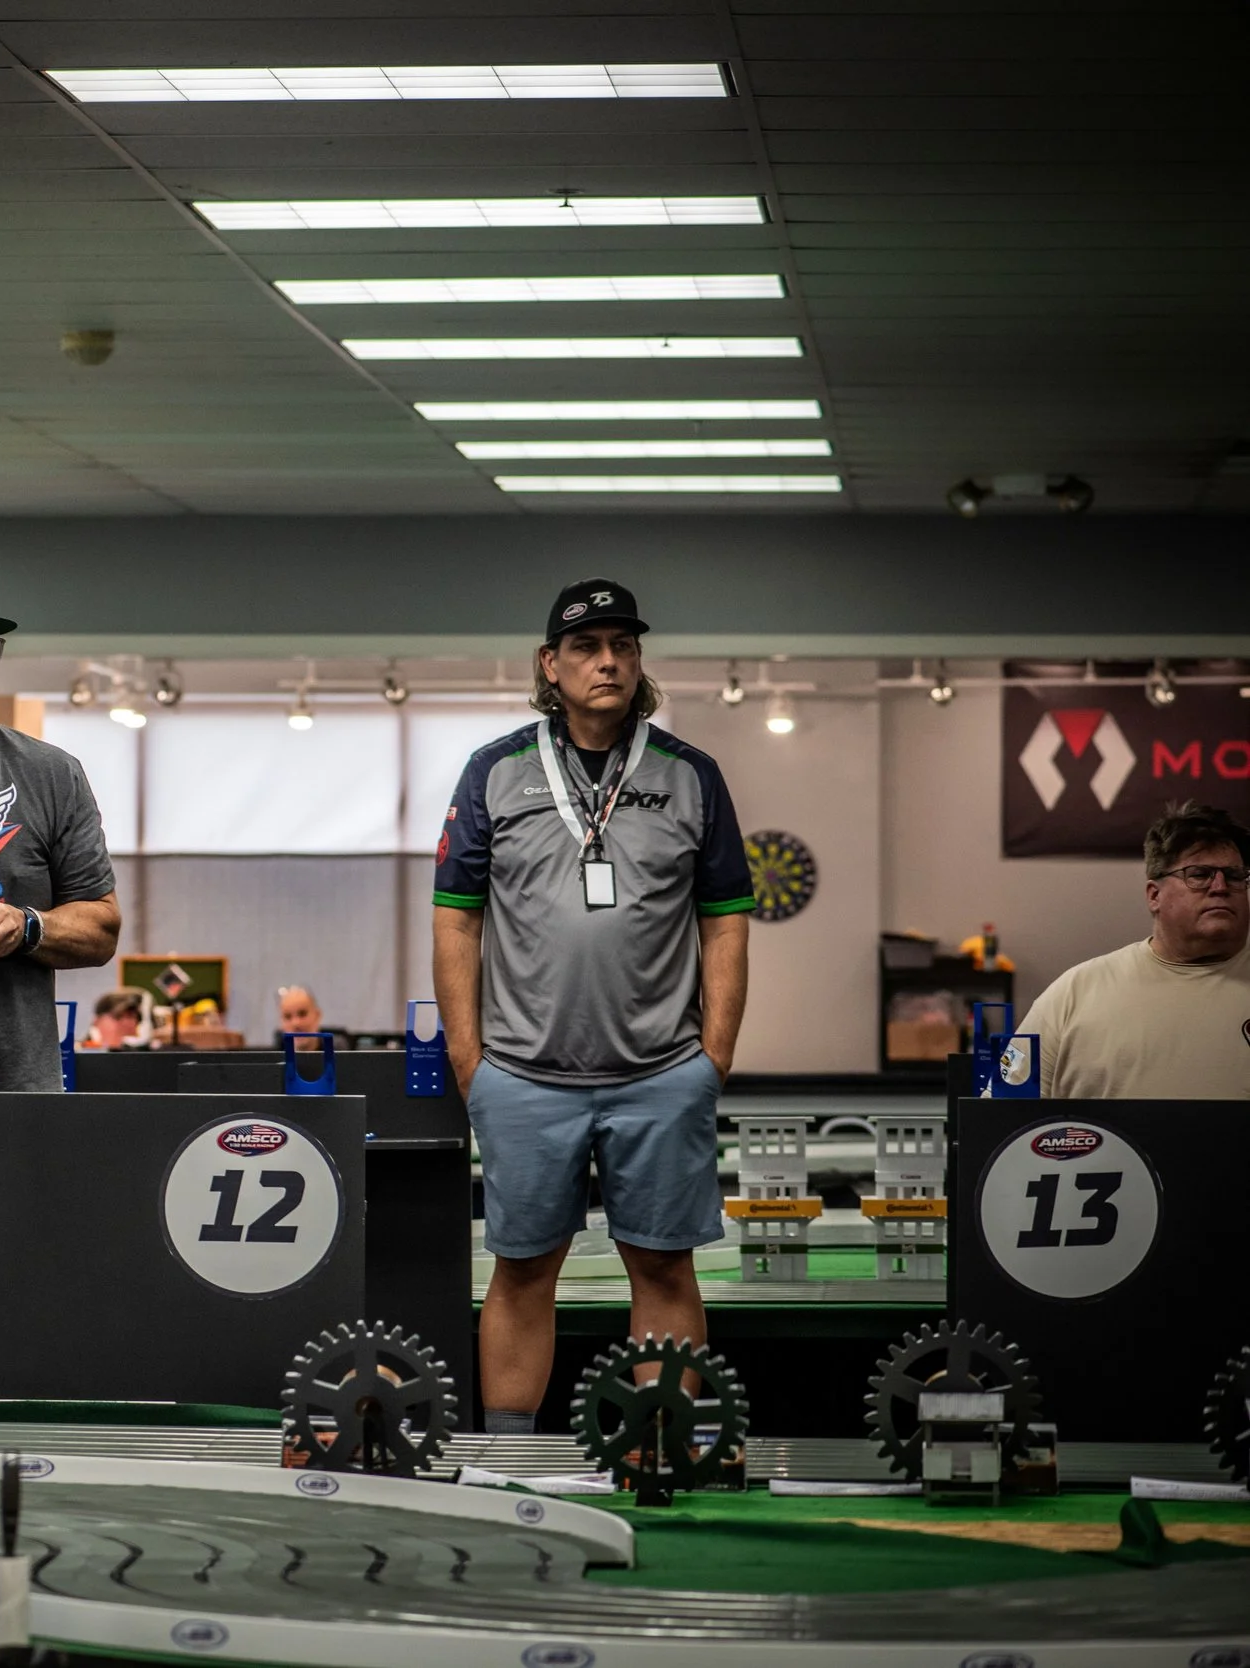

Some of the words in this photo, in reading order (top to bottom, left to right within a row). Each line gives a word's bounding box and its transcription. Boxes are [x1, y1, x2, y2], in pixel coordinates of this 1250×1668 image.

[224, 1134, 282, 1144] AMSCO
[1038, 1136, 1097, 1148] AMSCO
[198, 1169, 306, 1243] 12
[1016, 1171, 1124, 1249] 13
